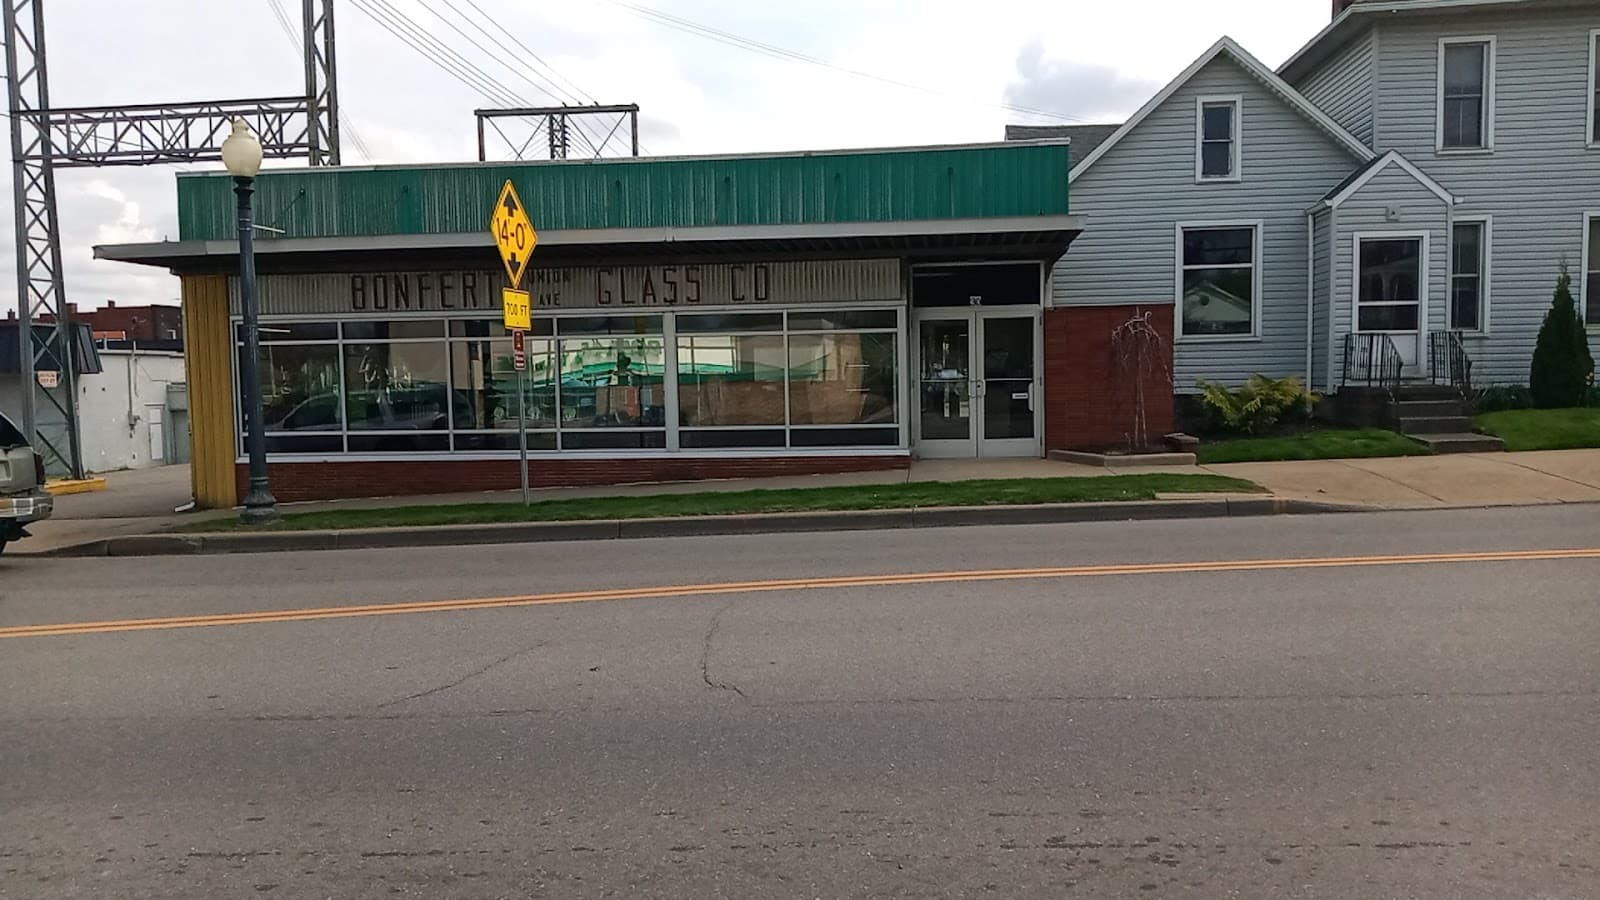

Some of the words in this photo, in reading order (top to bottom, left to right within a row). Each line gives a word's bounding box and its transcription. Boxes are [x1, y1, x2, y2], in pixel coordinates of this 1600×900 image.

[528, 269, 571, 284] UNION
[351, 273, 498, 310] BONFERT
[597, 266, 701, 305] GLASS
[730, 264, 769, 302] CO
[539, 292, 561, 306] AVE
[520, 304, 528, 317] FT
